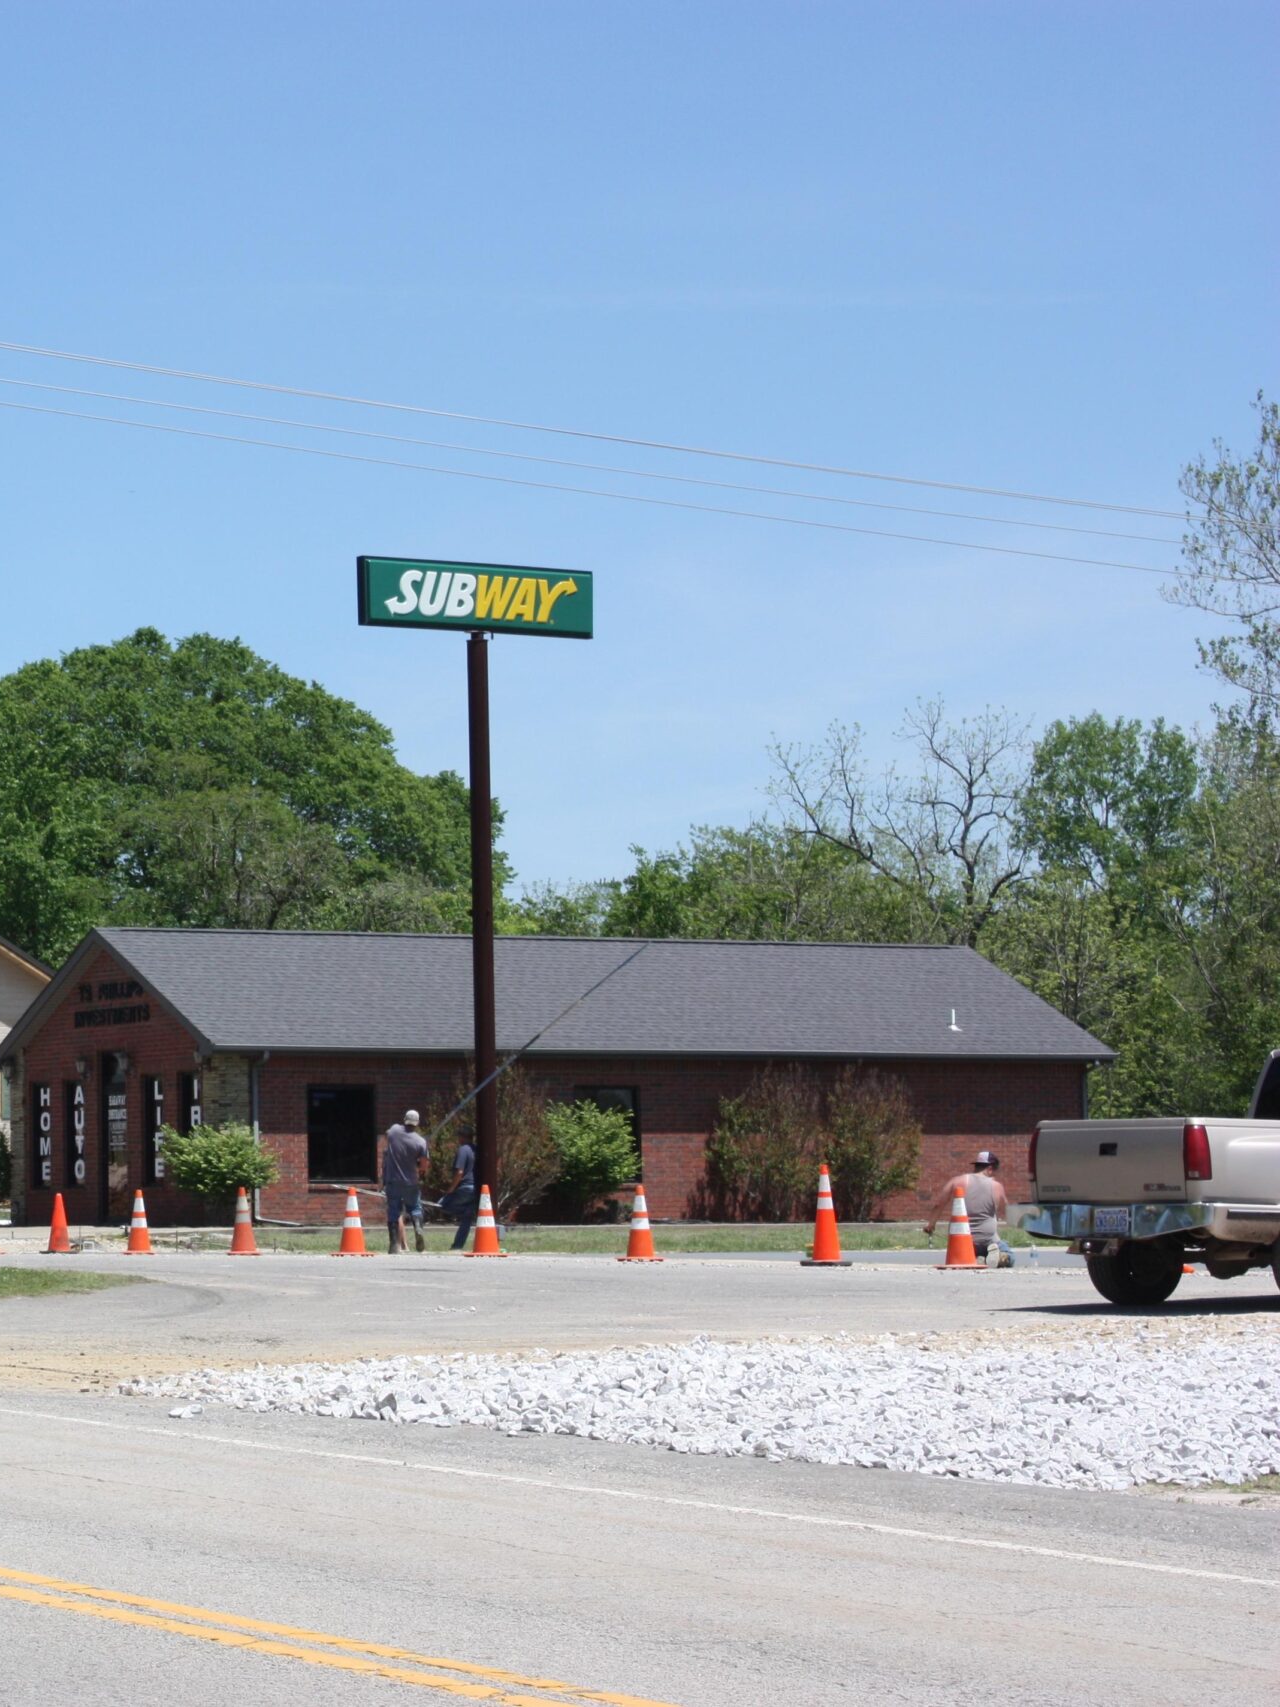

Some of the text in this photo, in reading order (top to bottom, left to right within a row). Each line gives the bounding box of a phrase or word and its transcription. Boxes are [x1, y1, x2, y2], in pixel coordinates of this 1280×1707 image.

[384, 569, 578, 623] SUBWAY
[40, 1087, 51, 1180] HOME
[74, 1085, 85, 1179] AUTO
[153, 1080, 165, 1178] LIFE
